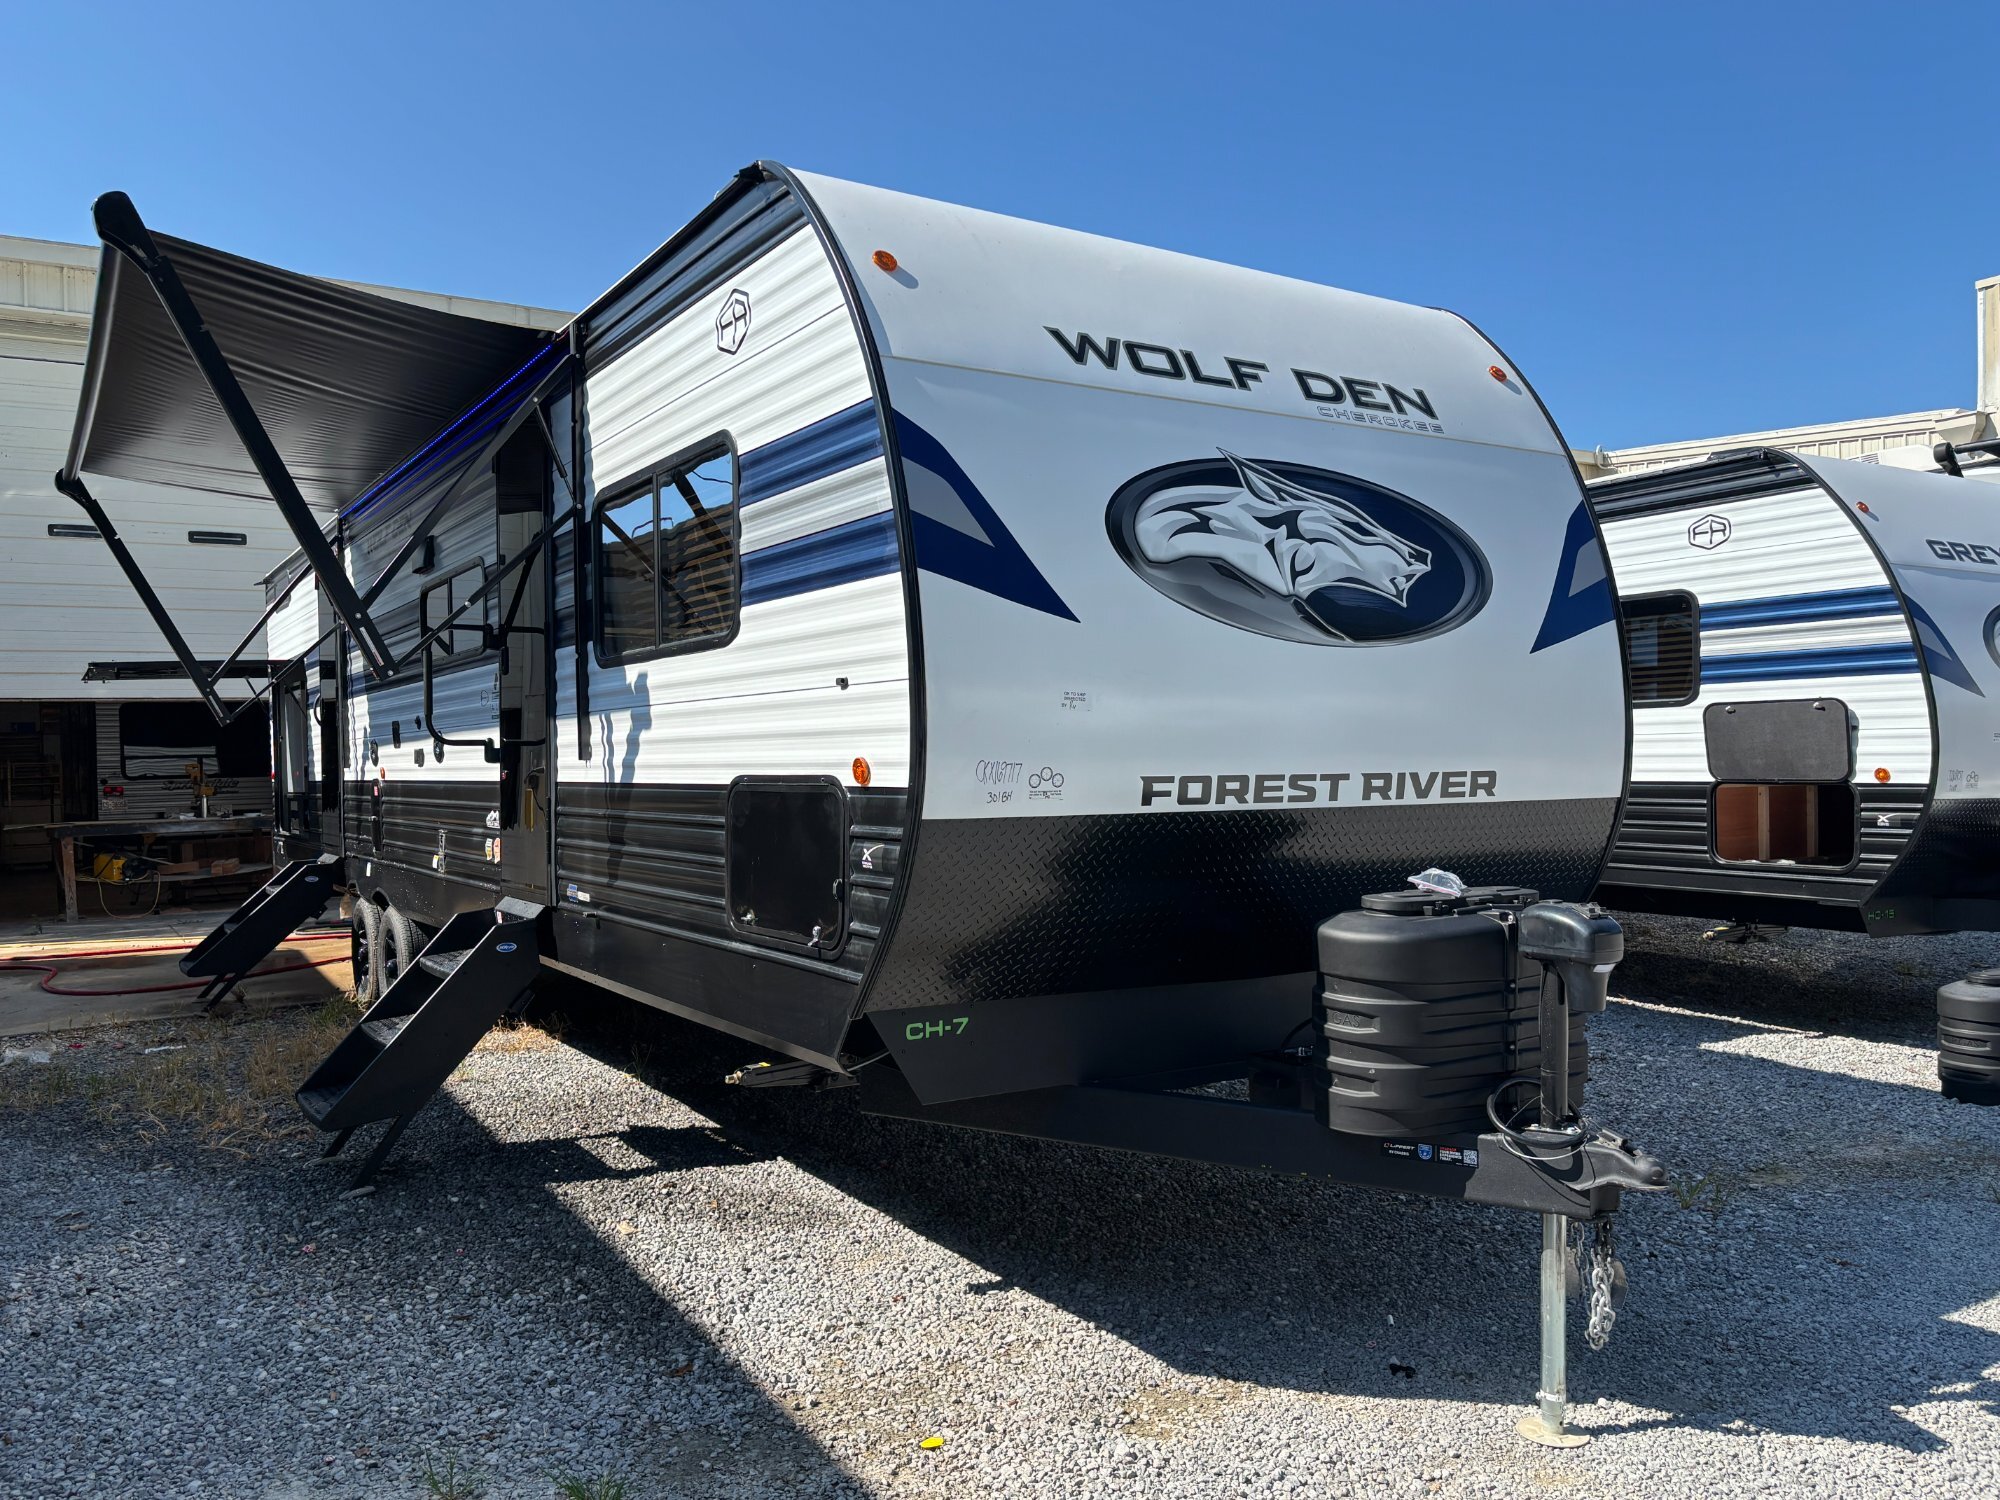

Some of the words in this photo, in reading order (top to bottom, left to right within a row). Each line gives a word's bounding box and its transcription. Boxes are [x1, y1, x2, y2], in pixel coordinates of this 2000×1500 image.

[1042, 325, 1270, 391] WOLF
[1290, 367, 1439, 420] DEN
[1317, 405, 1445, 434] CHEROKEE
[1140, 773, 1350, 807] FOREST
[1361, 770, 1497, 801] RIVER
[905, 1017, 969, 1041] CH-7
